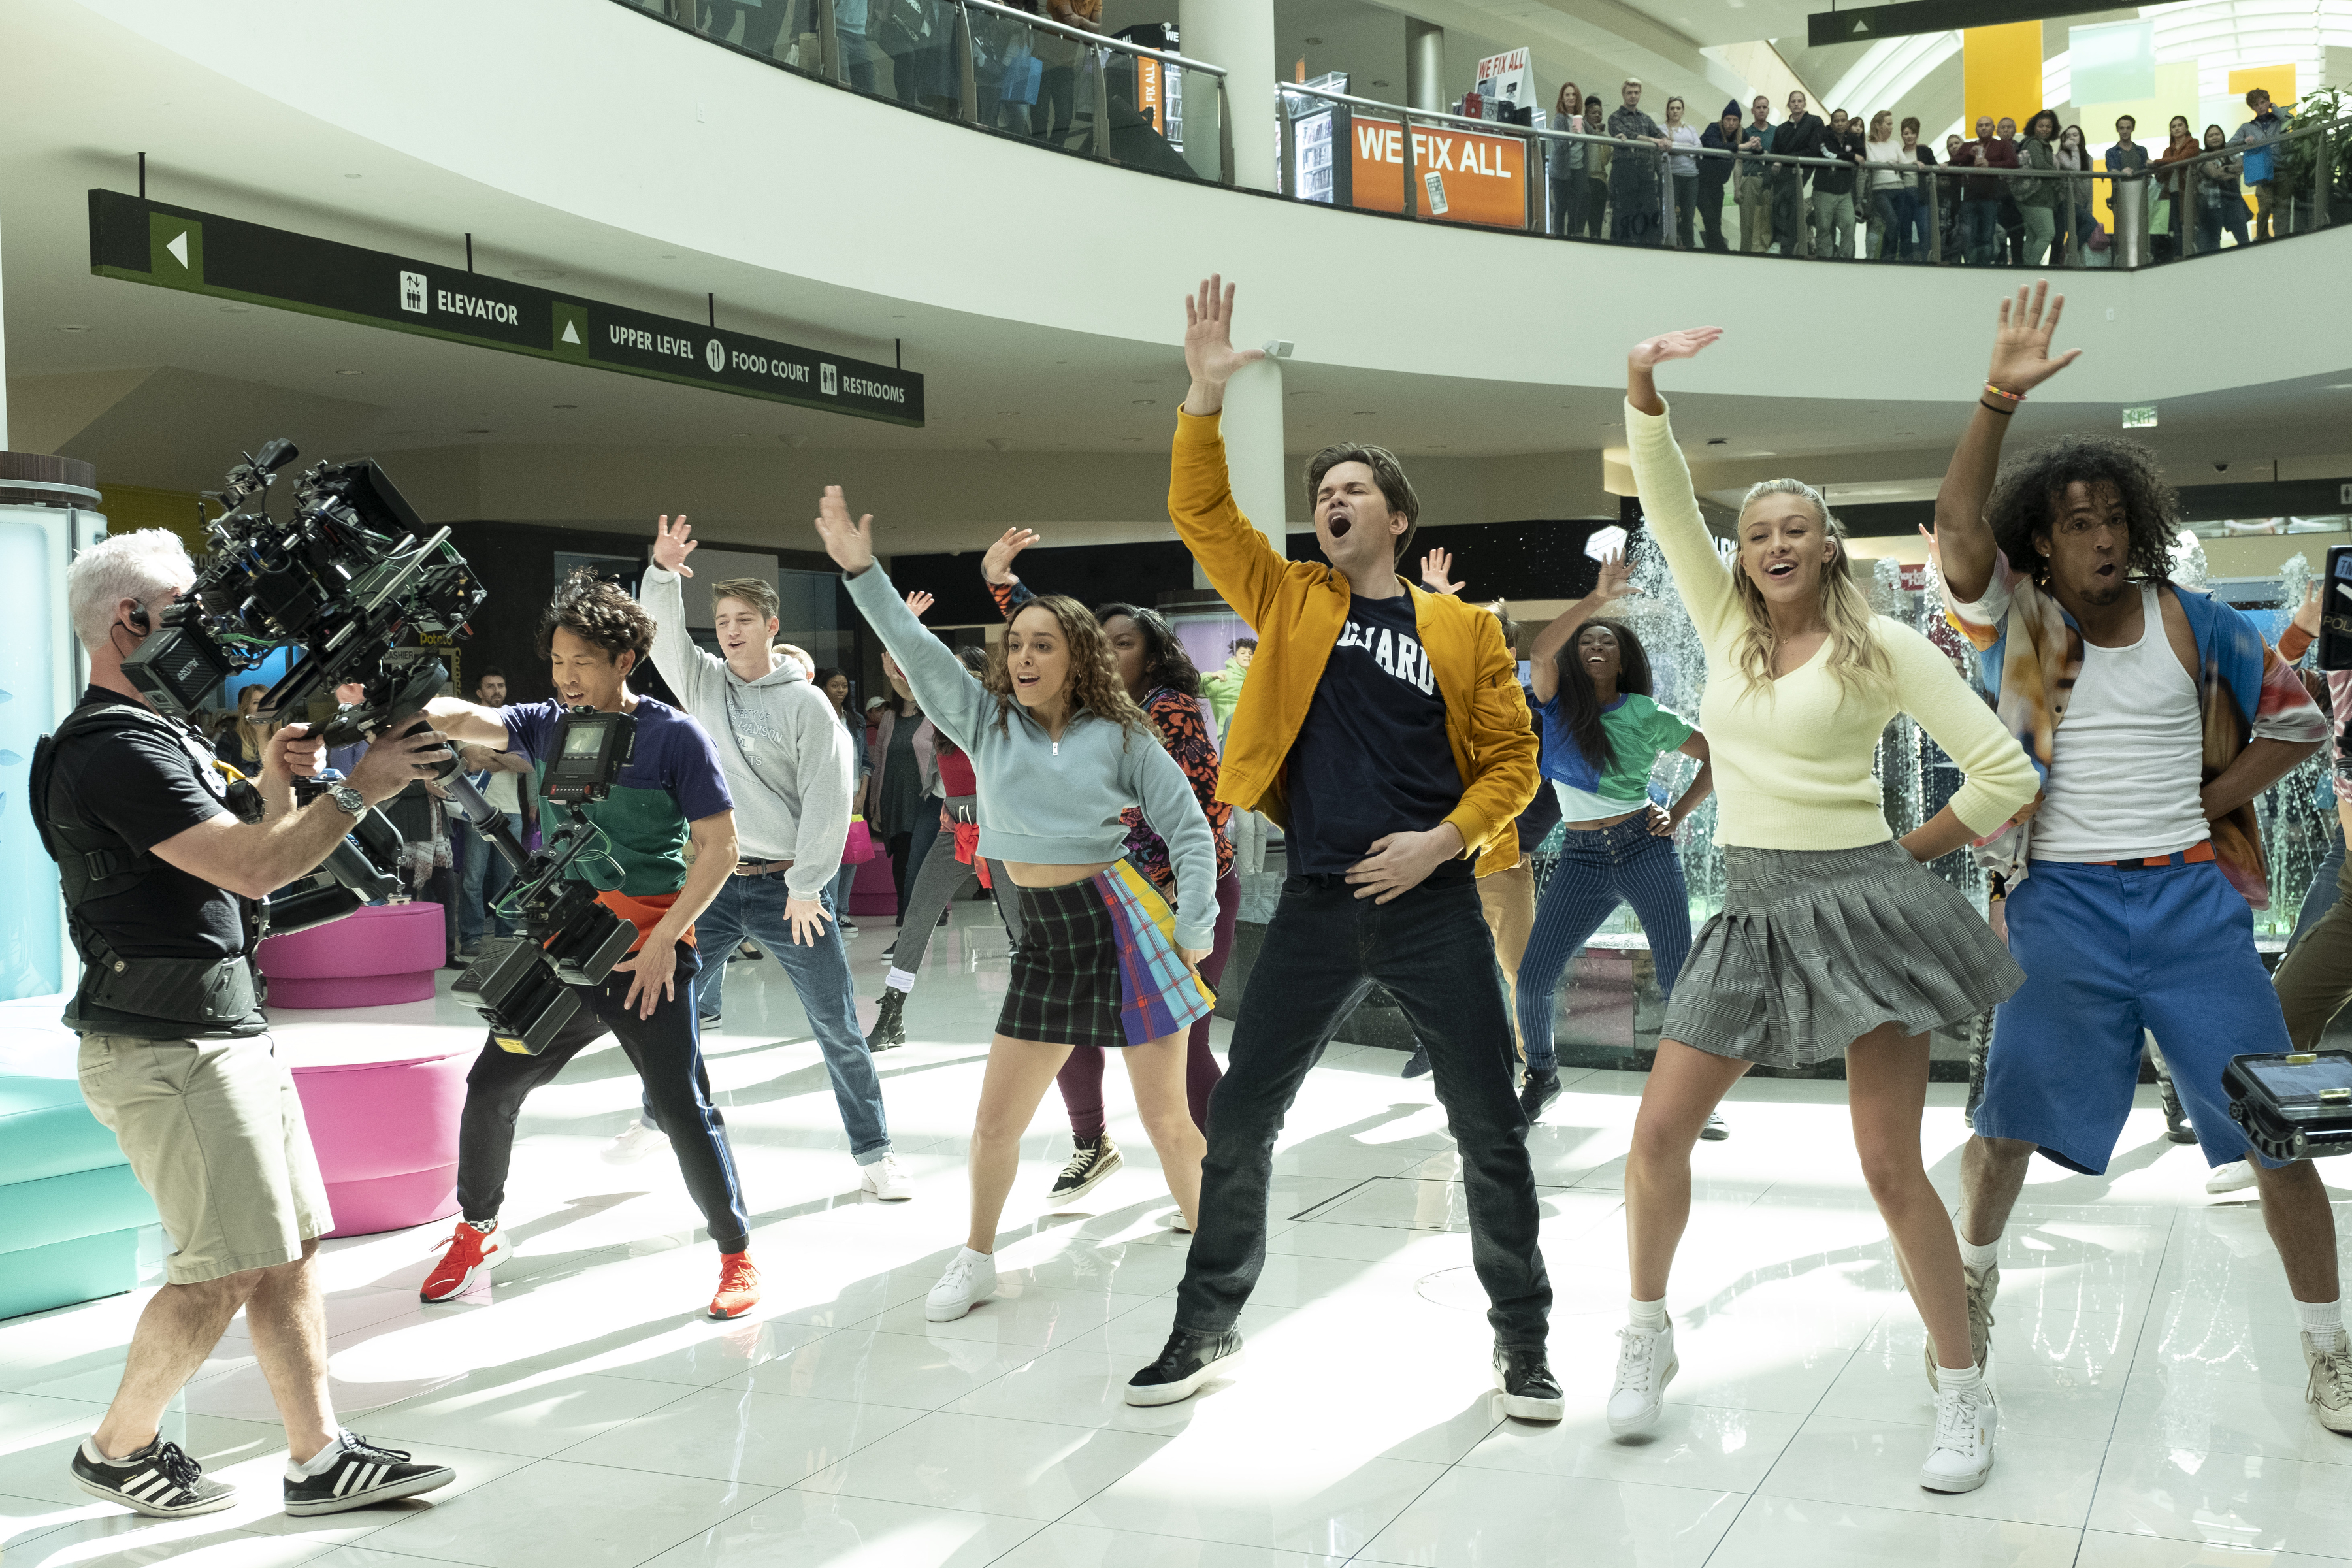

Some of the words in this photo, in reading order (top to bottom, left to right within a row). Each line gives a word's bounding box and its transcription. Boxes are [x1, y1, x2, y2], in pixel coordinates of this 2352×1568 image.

[1166, 30, 1179, 42] WE
[1145, 63, 1156, 84] ALL
[1478, 59, 1492, 80] WE
[1492, 55, 1508, 76] FIX
[1508, 50, 1524, 73] ALL
[1145, 85, 1156, 102] FIX
[1357, 125, 1403, 164] WE
[1411, 133, 1454, 171] FIX
[1459, 140, 1511, 178] ALL
[438, 289, 519, 326] ELEVATOR
[610, 324, 653, 351] UPPER
[657, 335, 694, 359] LEVEL
[732, 351, 768, 374] FOOD
[771, 359, 810, 383] COURT
[843, 376, 905, 404] RESTROOMS
[420, 632, 453, 645] Potato
[384, 651, 414, 660] CASHIER
